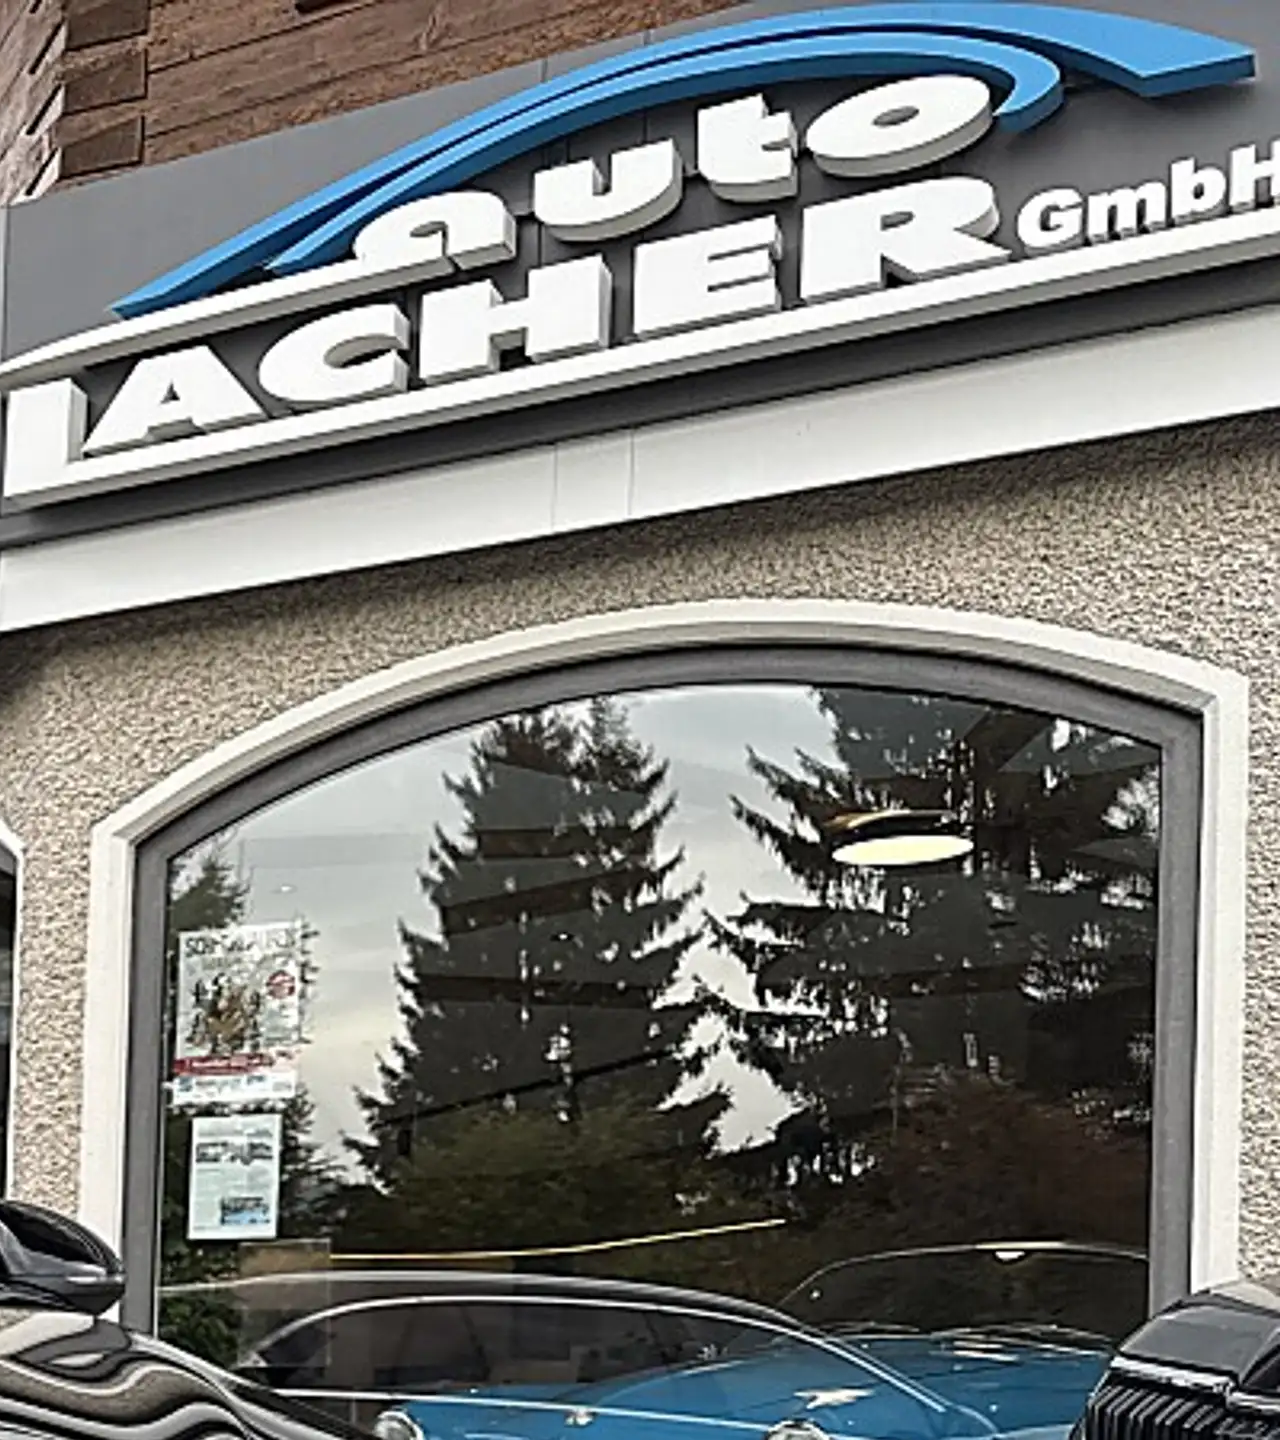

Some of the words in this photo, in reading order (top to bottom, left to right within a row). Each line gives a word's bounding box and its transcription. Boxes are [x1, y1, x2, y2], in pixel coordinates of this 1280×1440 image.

[352, 72, 996, 272] auto
[3, 175, 1012, 502] LACHER
[1017, 138, 1280, 257] GmbH
